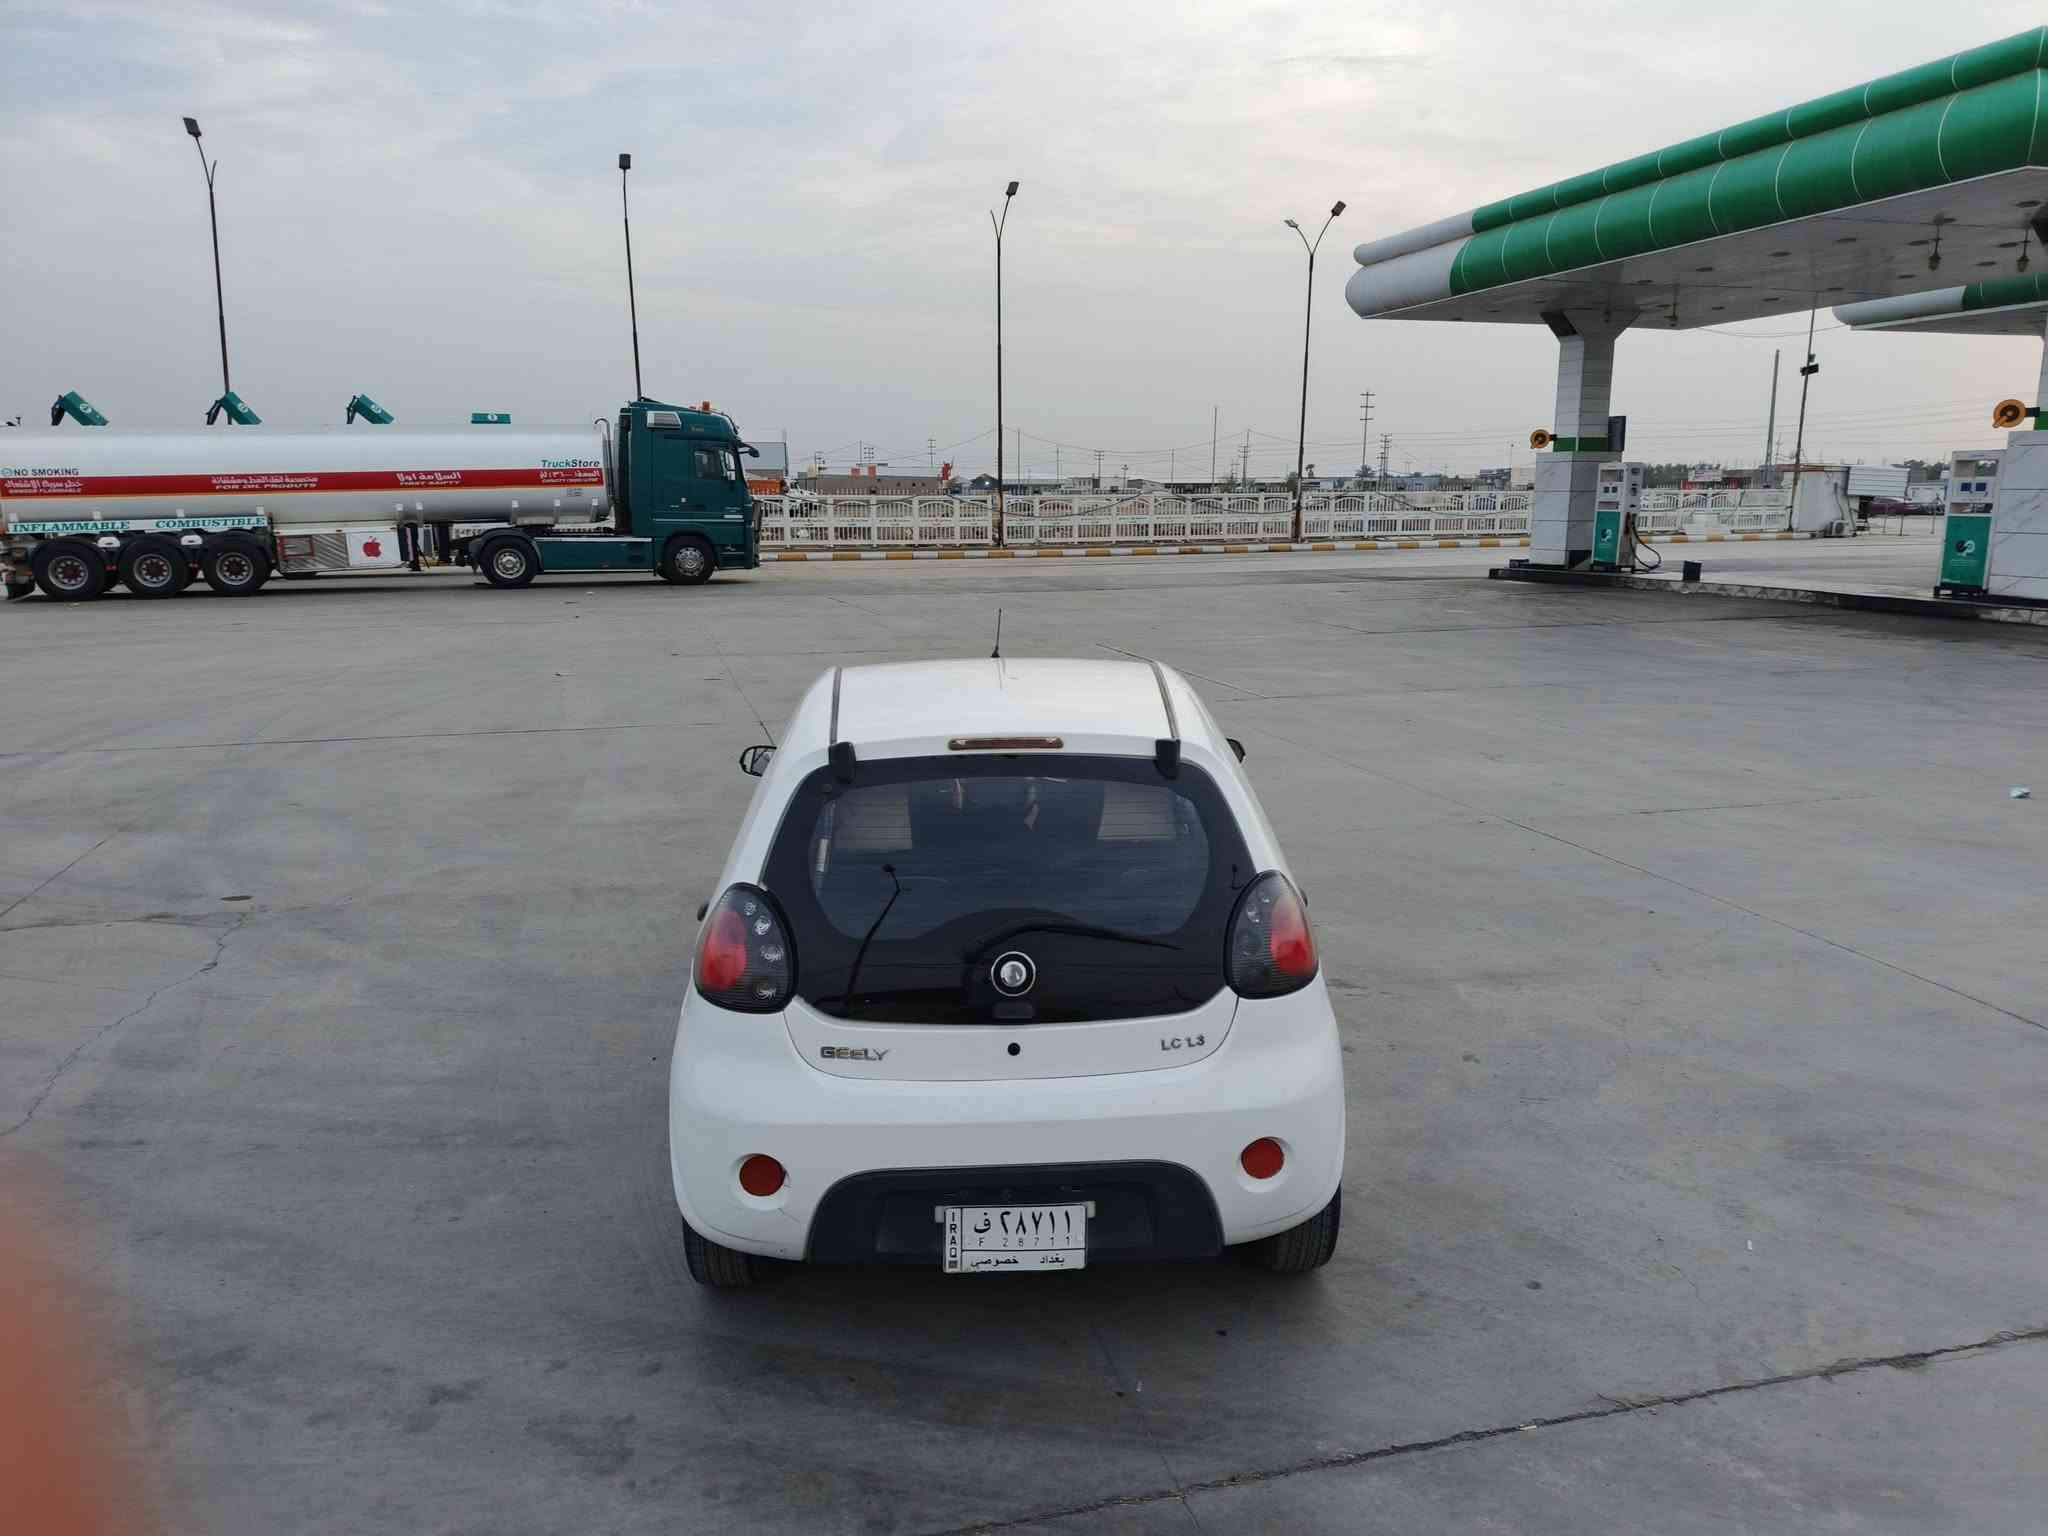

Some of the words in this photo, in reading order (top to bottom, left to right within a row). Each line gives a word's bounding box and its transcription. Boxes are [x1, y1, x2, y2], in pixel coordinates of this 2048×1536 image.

[541, 459, 600, 468] TruckStore
[14, 468, 29, 476] NO
[31, 467, 80, 476] SMOKING
[13, 521, 130, 532] INFLAMMABLE
[155, 517, 265, 528] COMBUSTIBLE
[821, 1047, 889, 1061] GEELY
[970, 1255, 1019, 1267] خصوصي
[1039, 1253, 1065, 1267] بغداد
